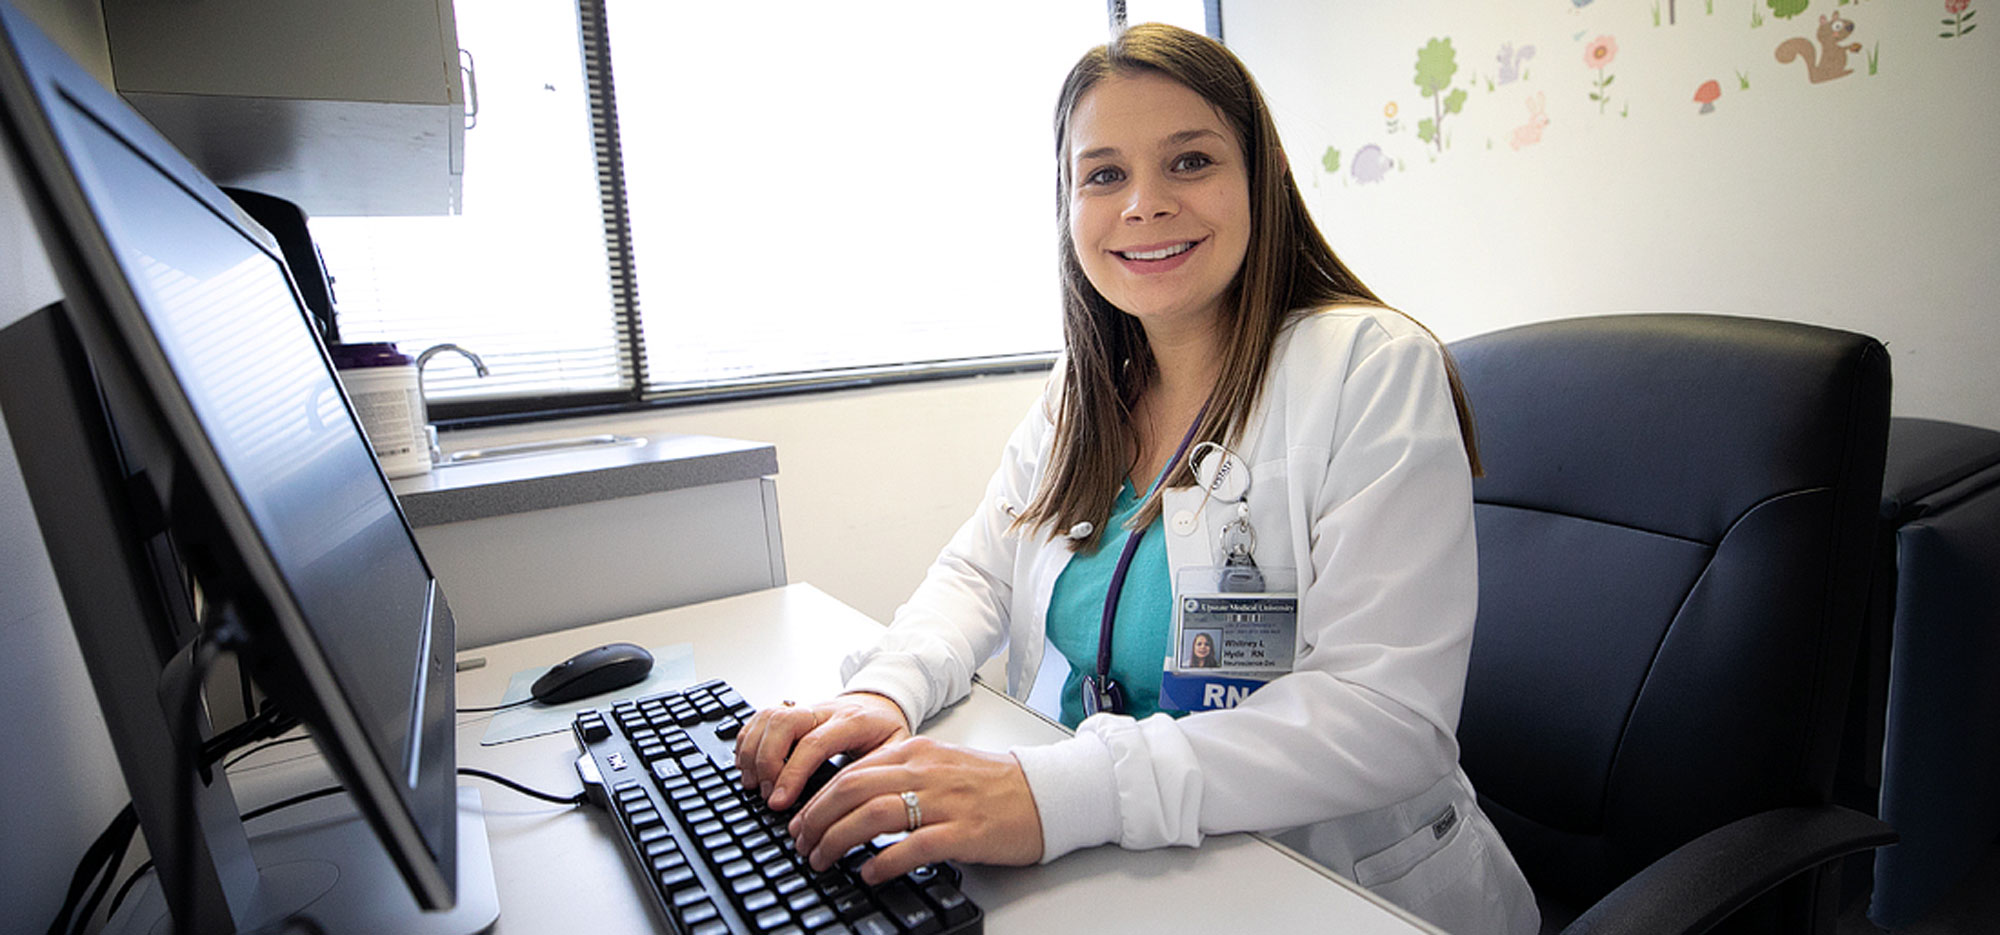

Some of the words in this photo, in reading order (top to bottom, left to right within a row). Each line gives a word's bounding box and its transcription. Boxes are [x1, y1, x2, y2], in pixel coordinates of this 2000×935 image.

[1201, 603, 1229, 612] Upstate
[1230, 603, 1257, 611] Medical
[1259, 603, 1294, 611] University
[1225, 640, 1257, 649] Whitney
[1224, 650, 1245, 659] Hyde
[1251, 650, 1265, 658] RN
[1203, 683, 1250, 709] RN
